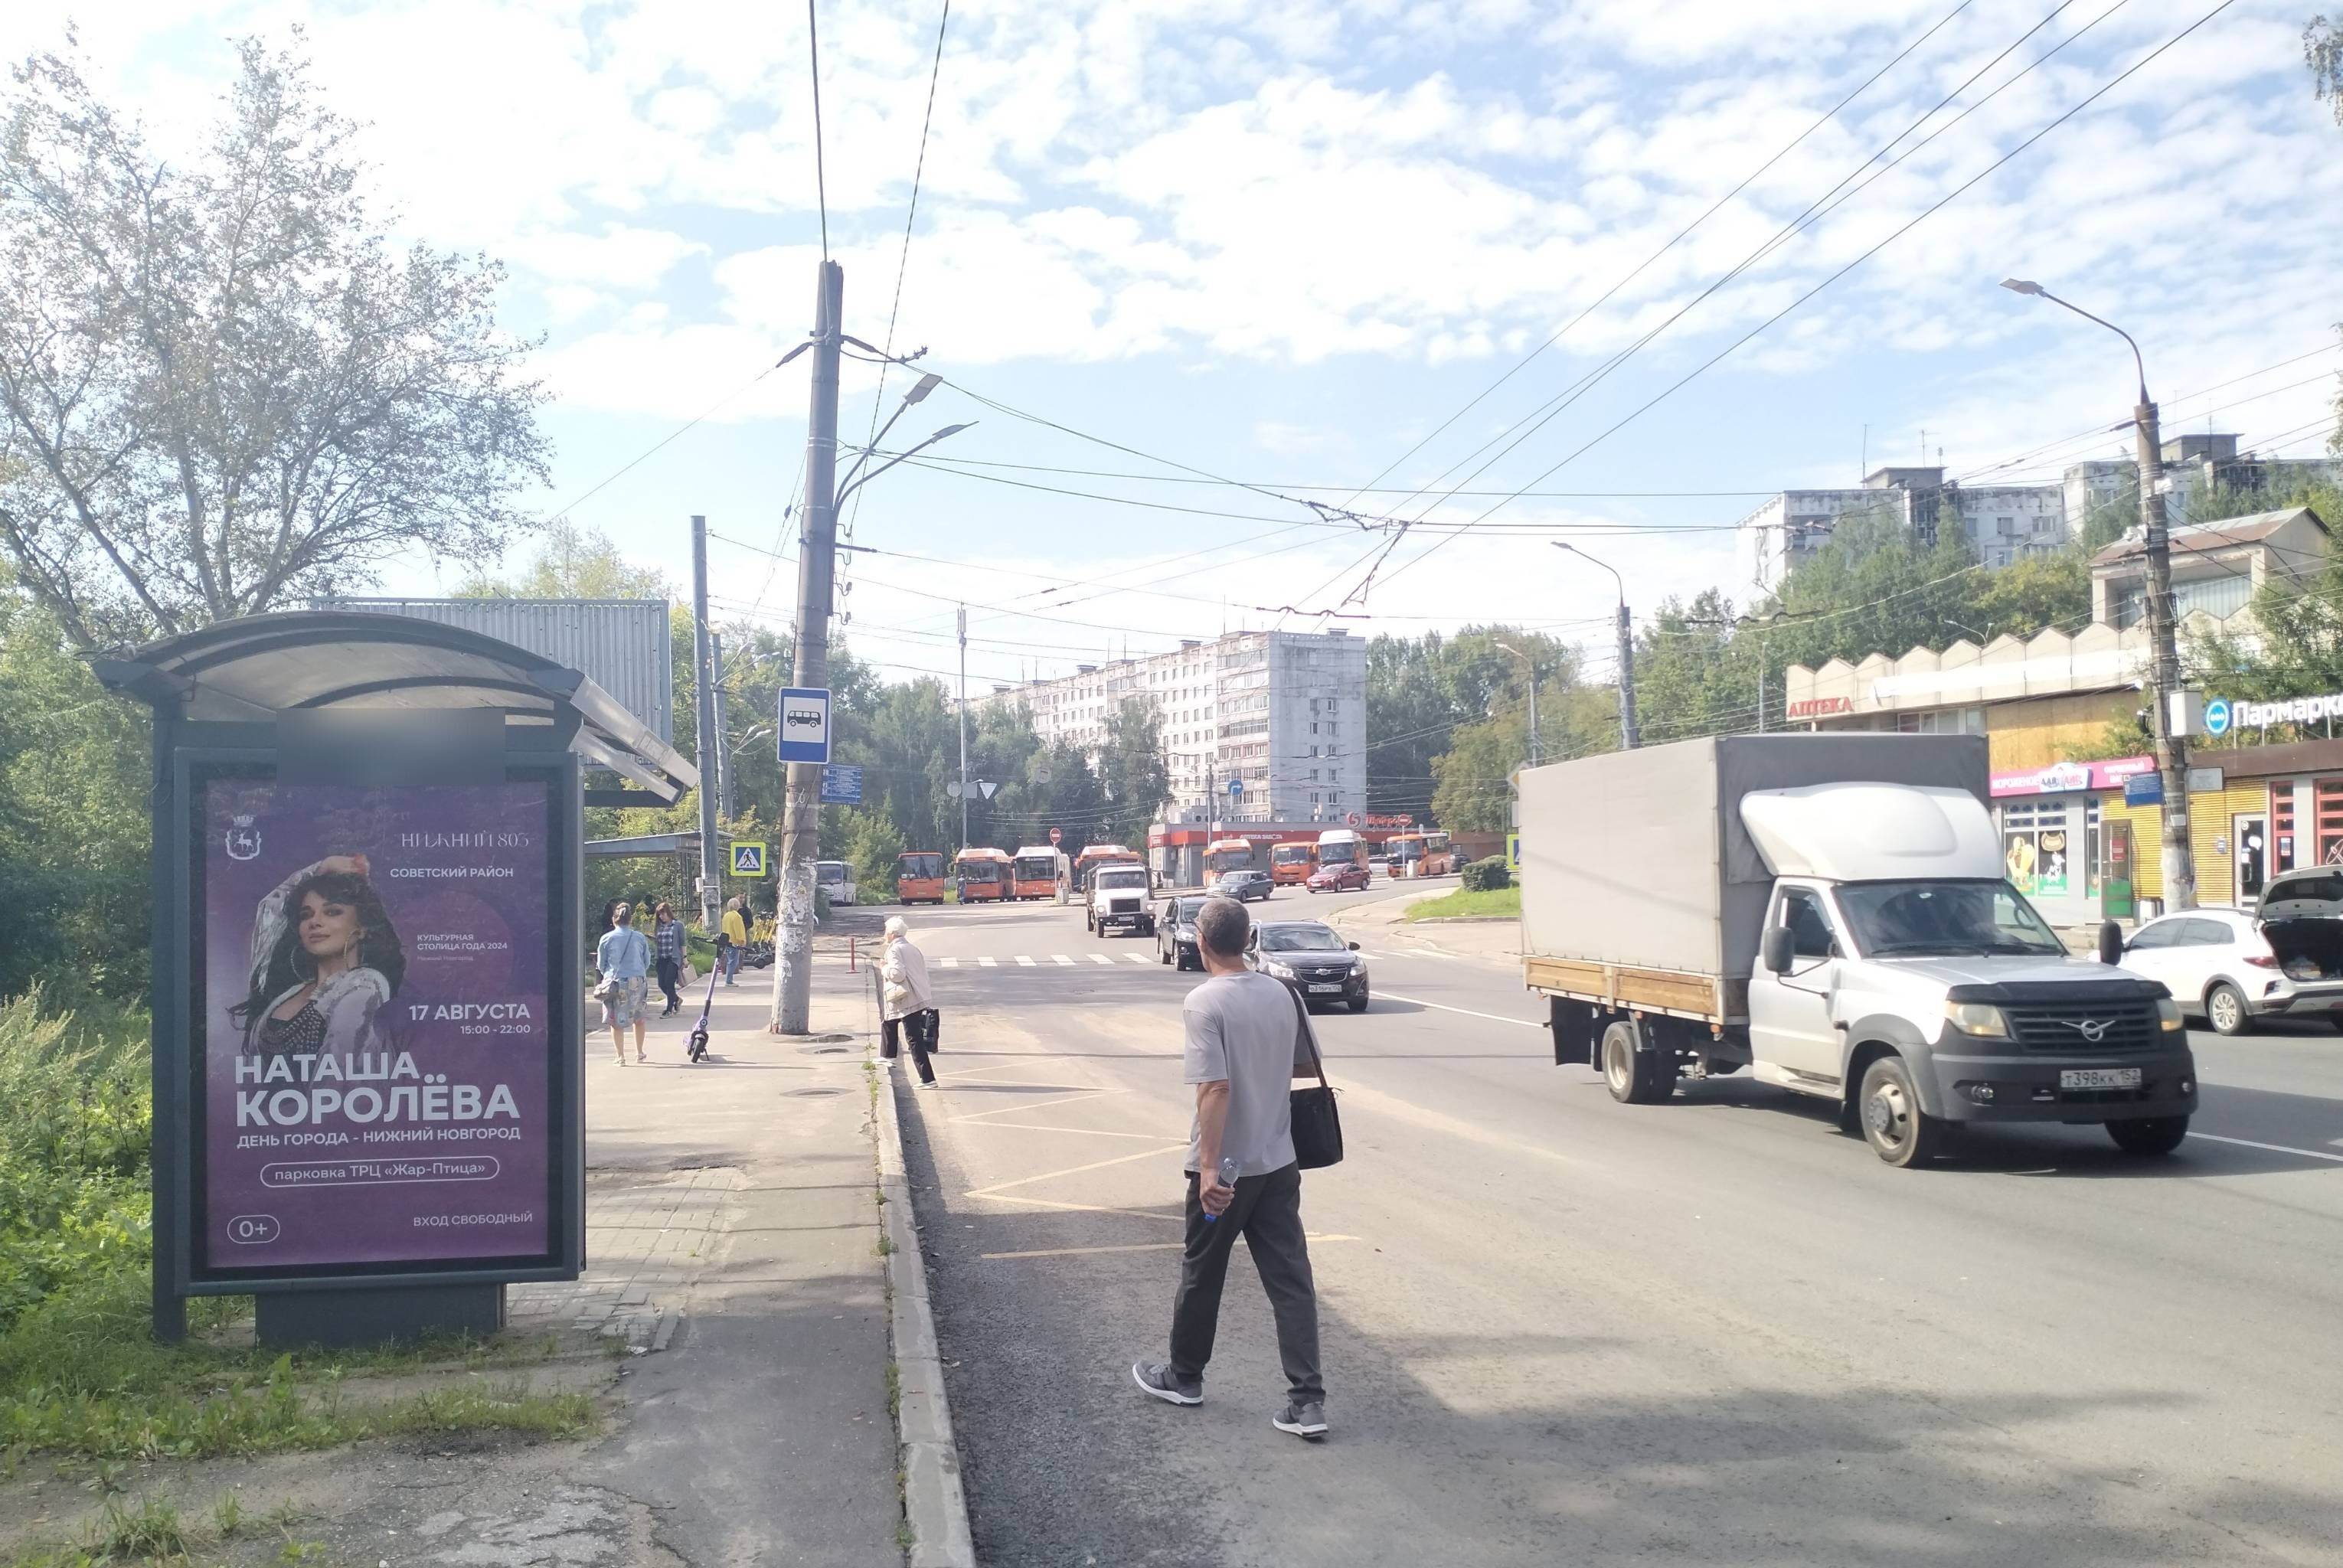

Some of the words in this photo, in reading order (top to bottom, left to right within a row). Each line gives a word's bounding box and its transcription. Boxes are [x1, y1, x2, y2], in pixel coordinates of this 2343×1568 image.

[1789, 696, 1854, 717] АПТЕКА
[390, 866, 467, 878] СОВЕТСКИЙ
[470, 865, 514, 877] РАЙОН
[408, 1005, 428, 1021] 17
[434, 1004, 531, 1020] АВГУСТА
[460, 1025, 490, 1034] 15:00
[500, 1024, 531, 1034] 22:00
[235, 1051, 420, 1084] НАТАША
[237, 1073, 521, 1127] КОРОЛЁВА
[237, 1134, 279, 1149] ДЕНЬ
[284, 1132, 348, 1146] ГОРОДА
[363, 1127, 433, 1143] НИЖНИЙ
[437, 1127, 521, 1142] НОВГОРОД
[275, 1167, 346, 1182] парковка
[349, 1165, 381, 1179] ТРЦ
[384, 1162, 485, 1179] «Жар-Птица»
[413, 1216, 449, 1227] ВХОД
[451, 1211, 533, 1225] СВОБОДНЫЙ
[239, 1221, 268, 1237] 0+
